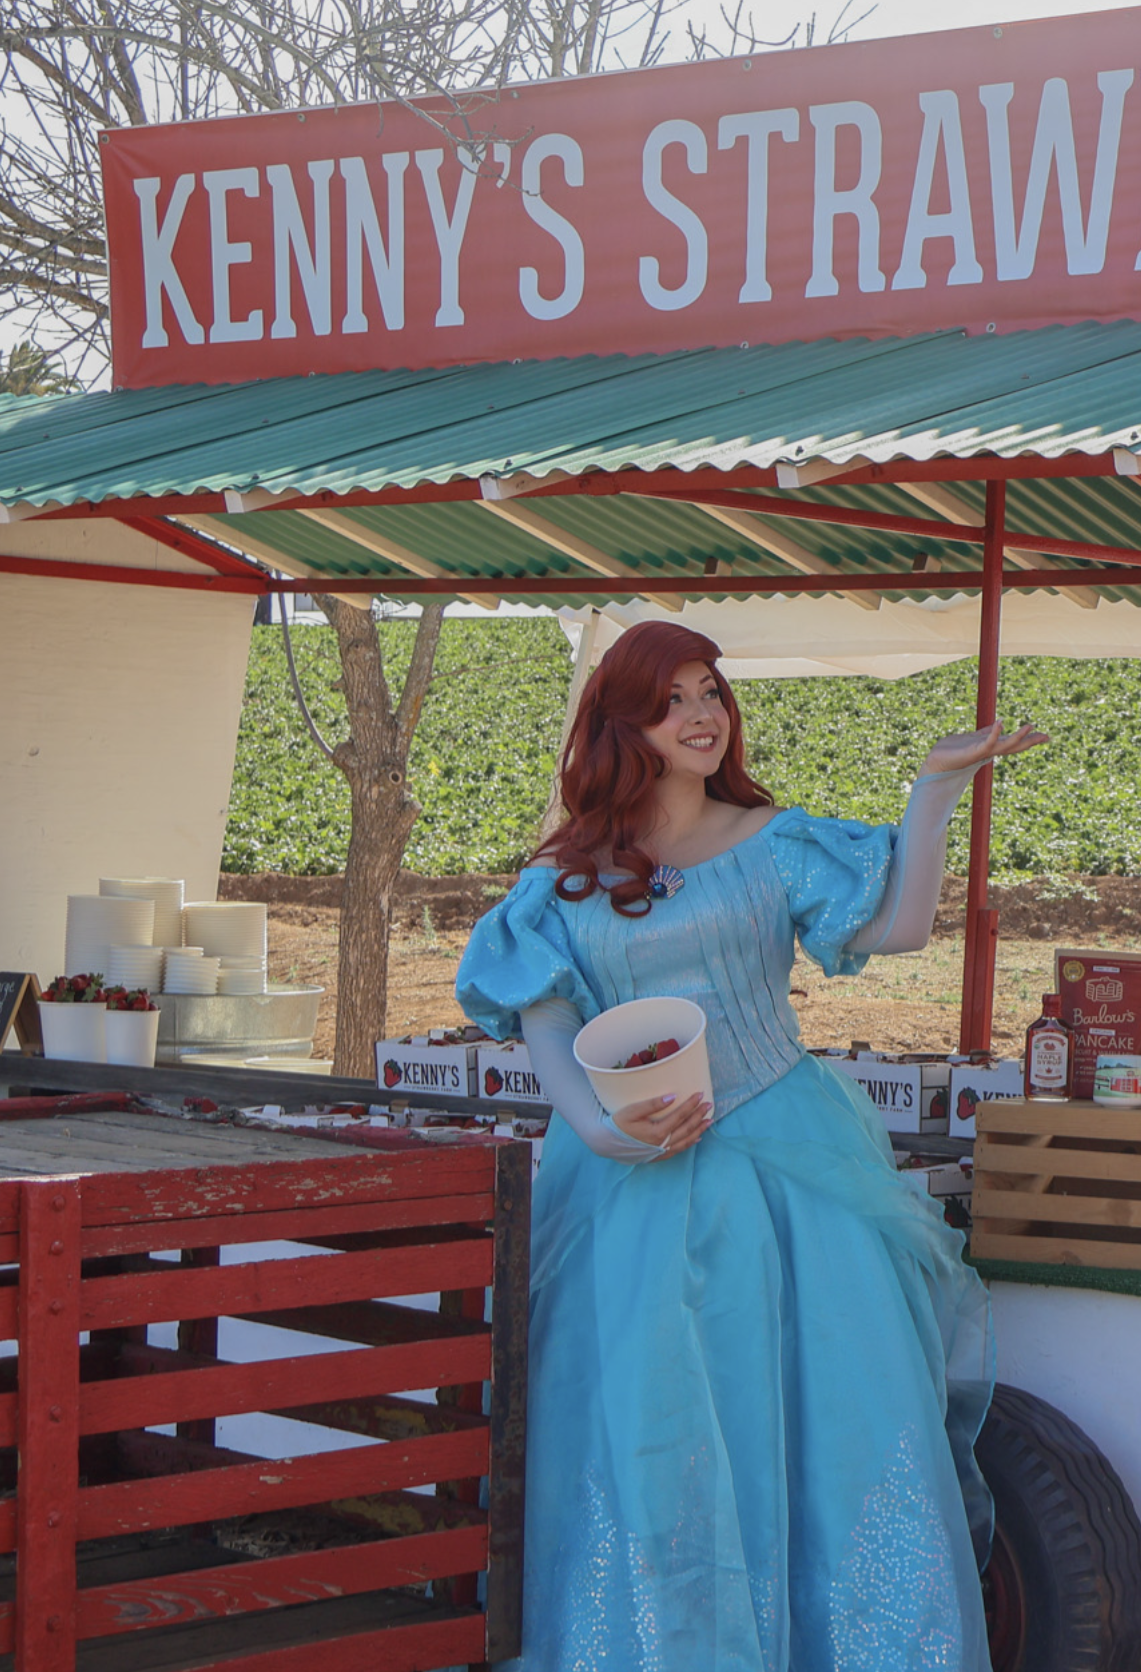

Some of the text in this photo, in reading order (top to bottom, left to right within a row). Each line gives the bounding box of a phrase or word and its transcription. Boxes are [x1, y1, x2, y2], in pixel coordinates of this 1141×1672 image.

[133, 132, 586, 349] KENNY'S
[1072, 1004, 1135, 1026] Barlow's
[403, 1062, 460, 1087] KENNY'S
